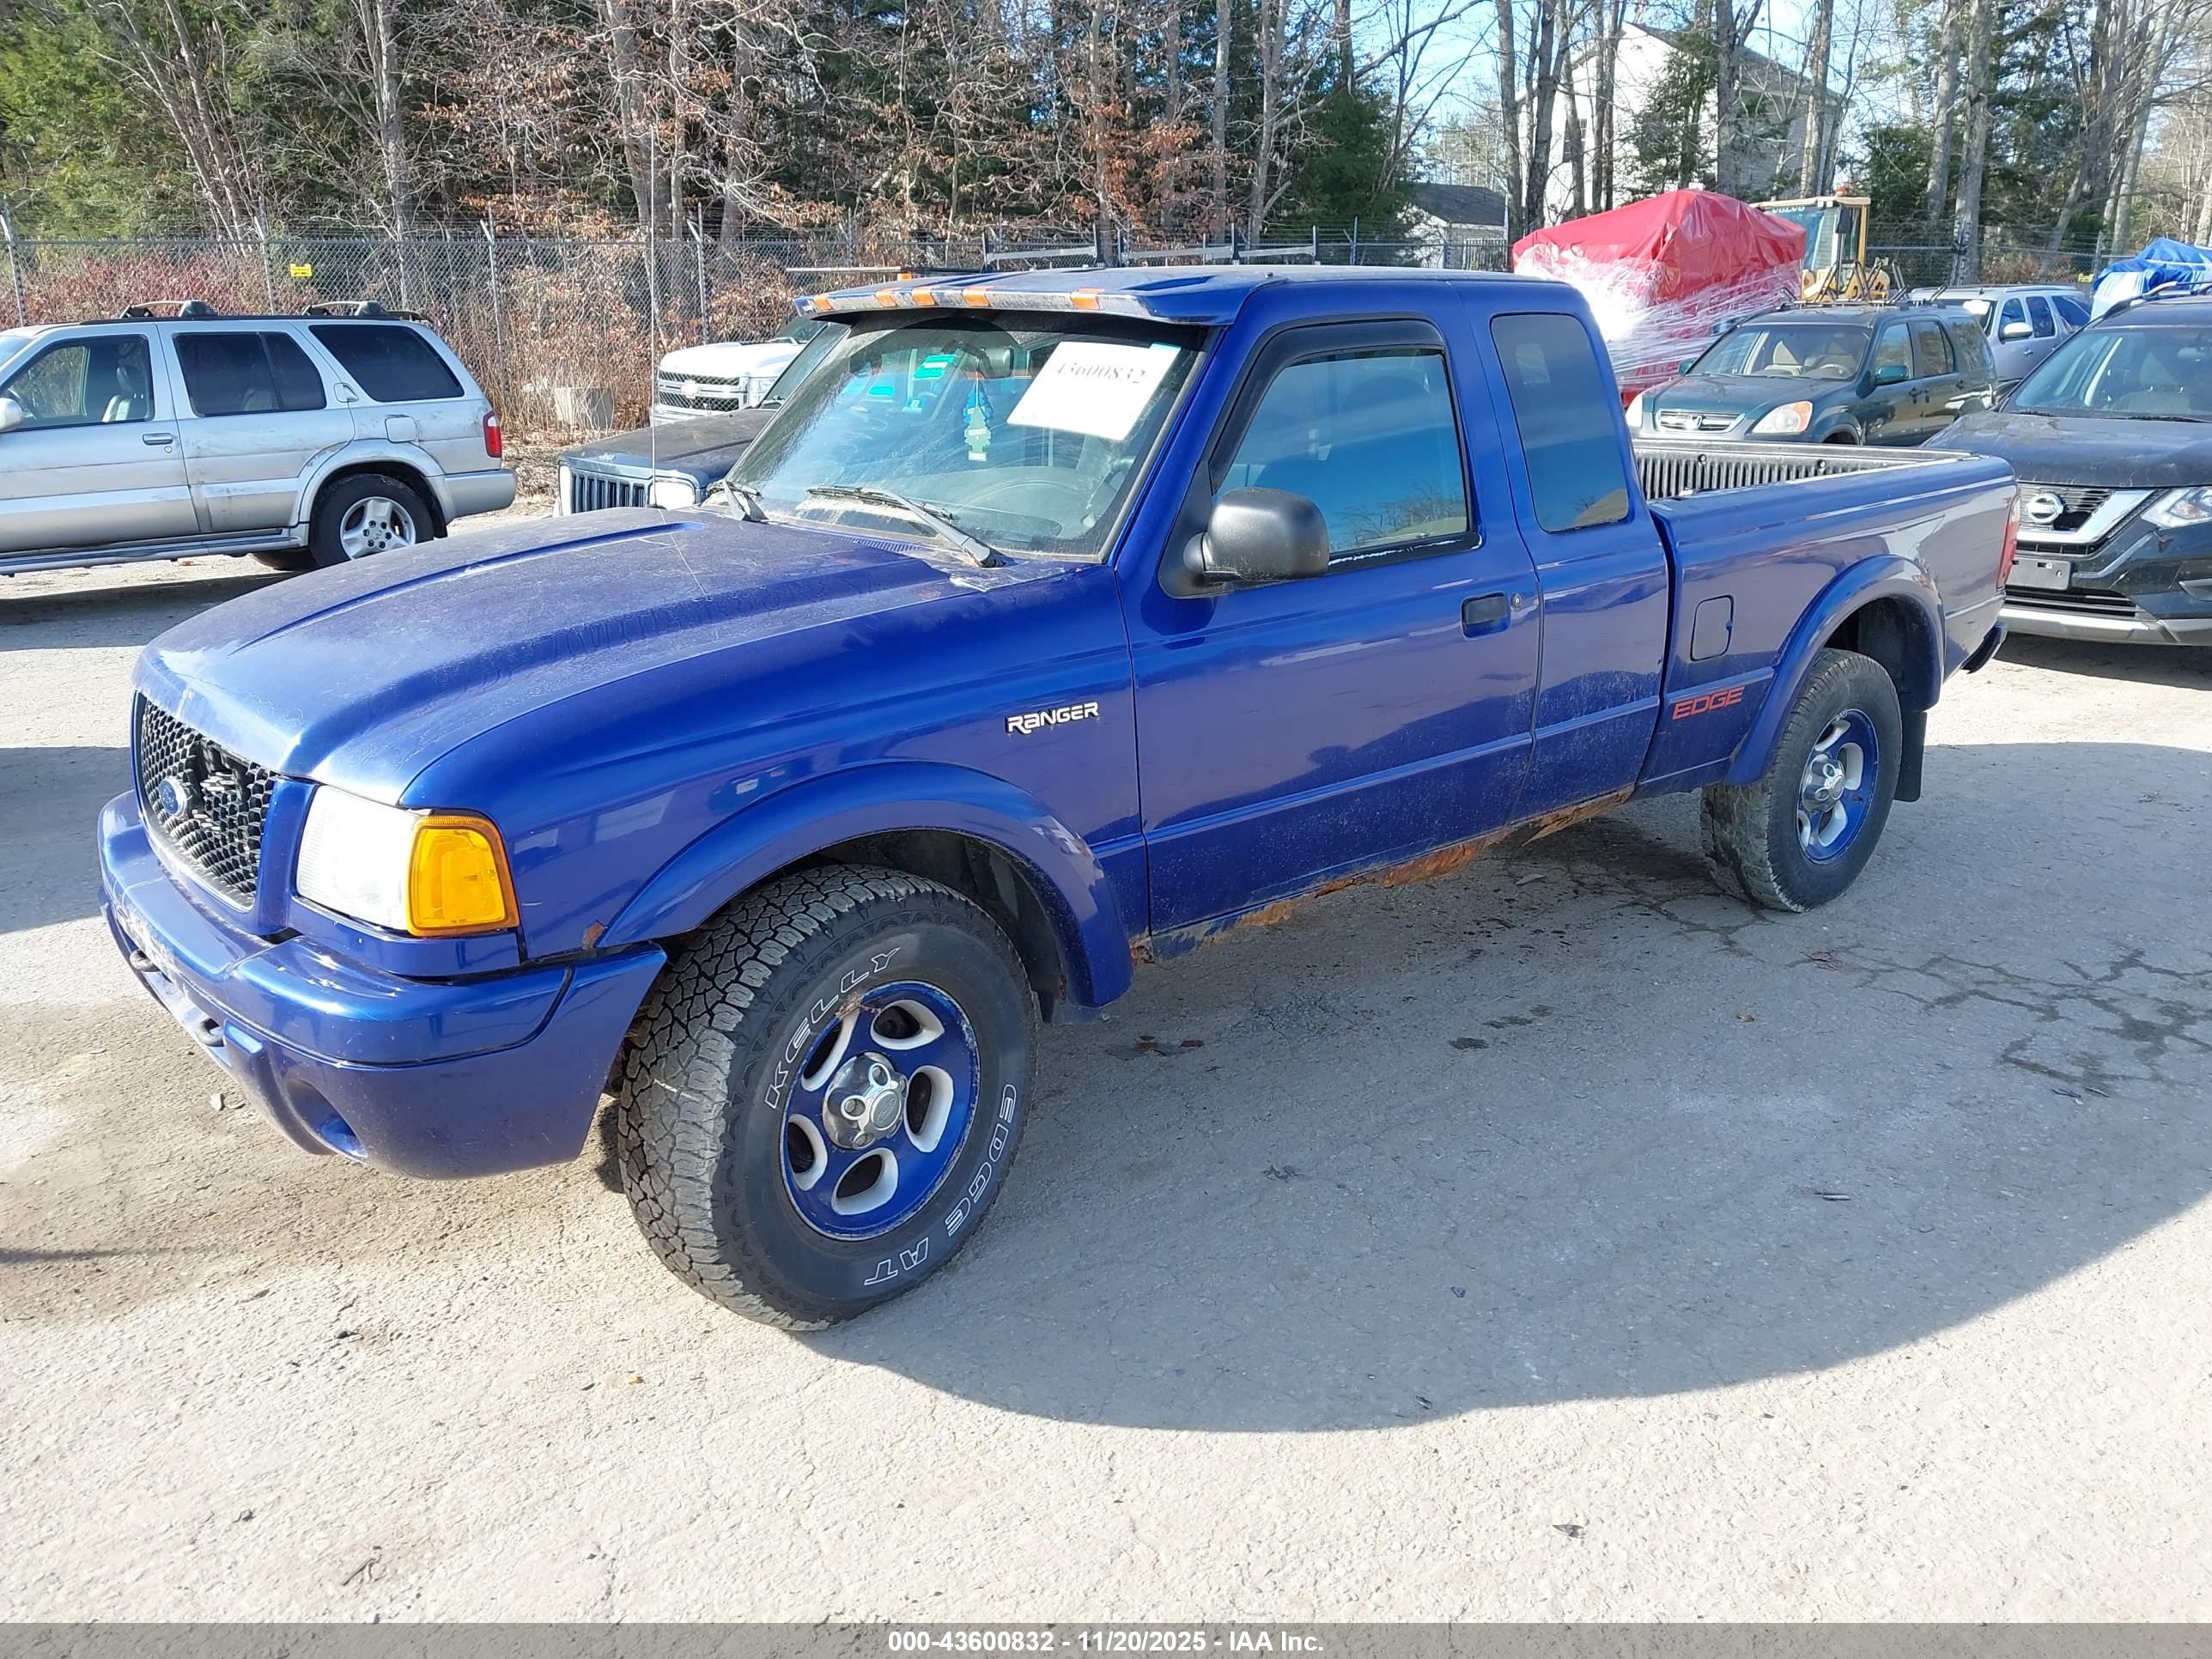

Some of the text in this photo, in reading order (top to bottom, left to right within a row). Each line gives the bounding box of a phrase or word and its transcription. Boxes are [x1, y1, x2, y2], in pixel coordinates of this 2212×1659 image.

[1672, 685, 1746, 720] EDGE
[764, 946, 901, 1109] KELLY
[863, 1084, 1018, 1285] EDGE AT
